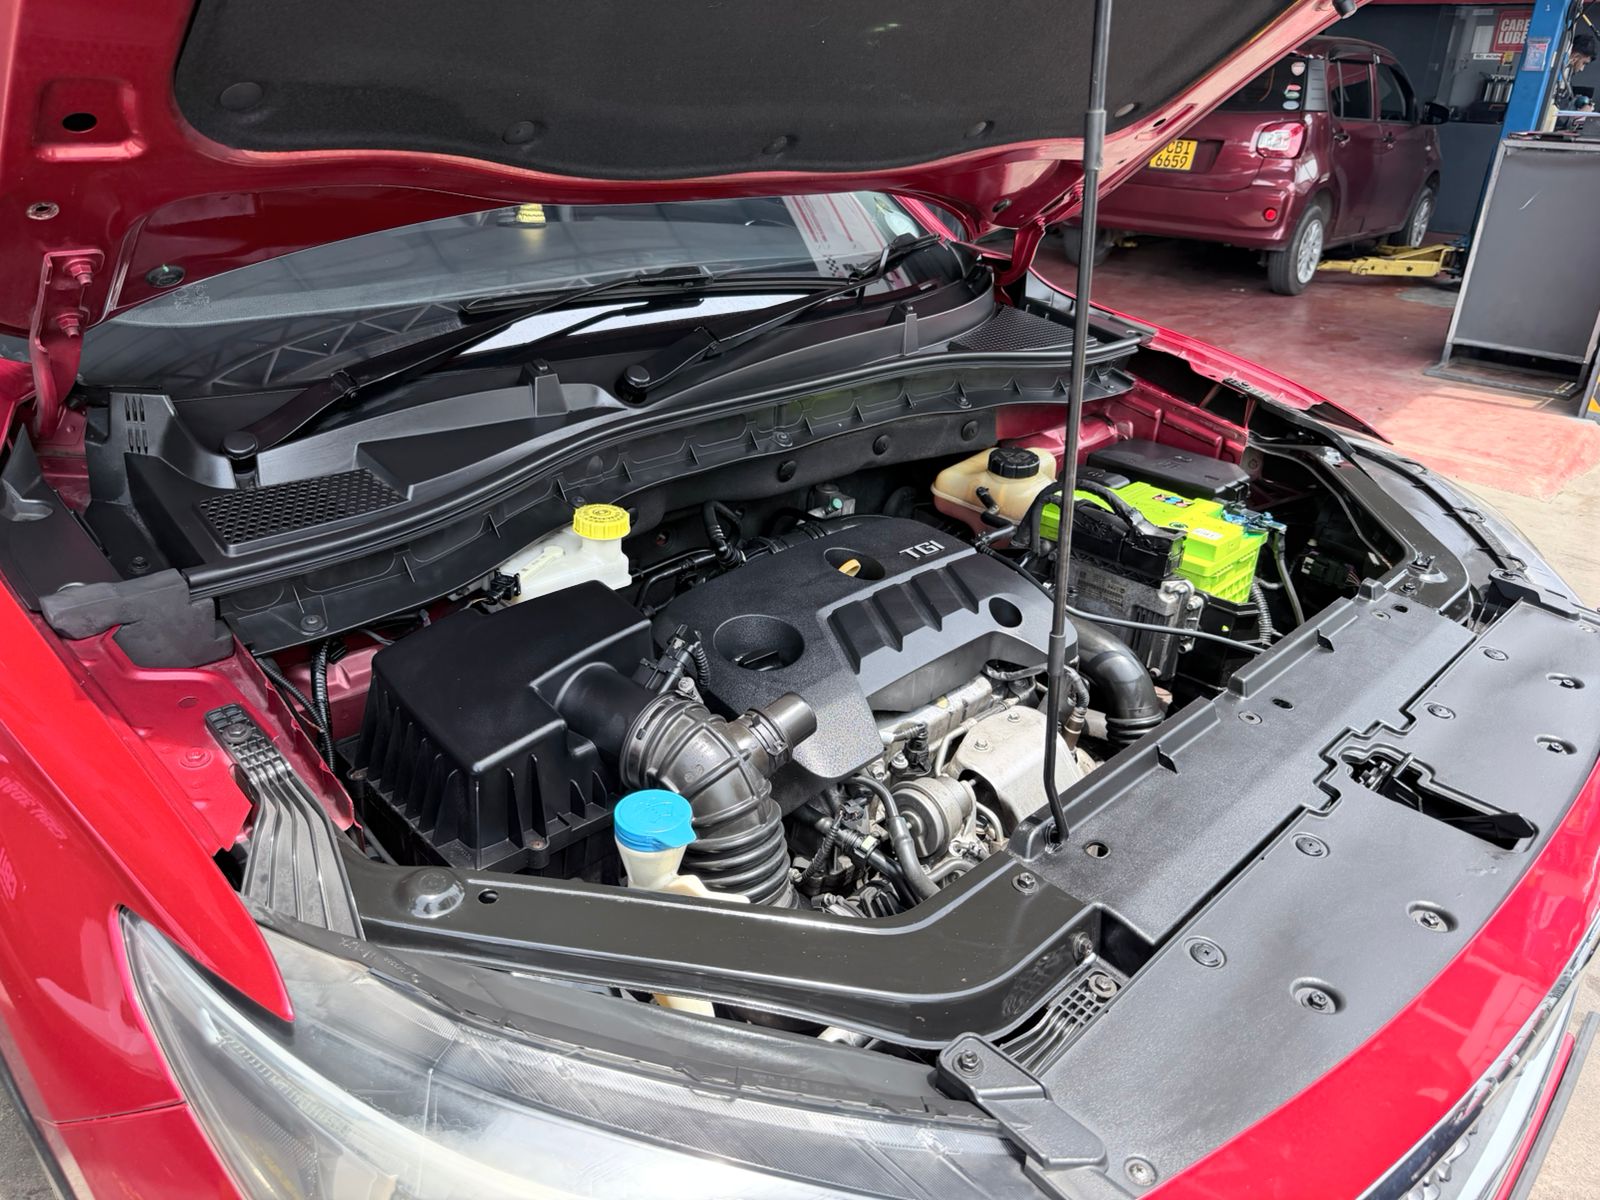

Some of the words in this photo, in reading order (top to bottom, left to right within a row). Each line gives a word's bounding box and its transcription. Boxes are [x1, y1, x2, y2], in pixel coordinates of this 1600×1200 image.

[1500, 19, 1531, 32] CARE
[1155, 154, 1188, 168] 6659
[898, 540, 945, 559] TGI
